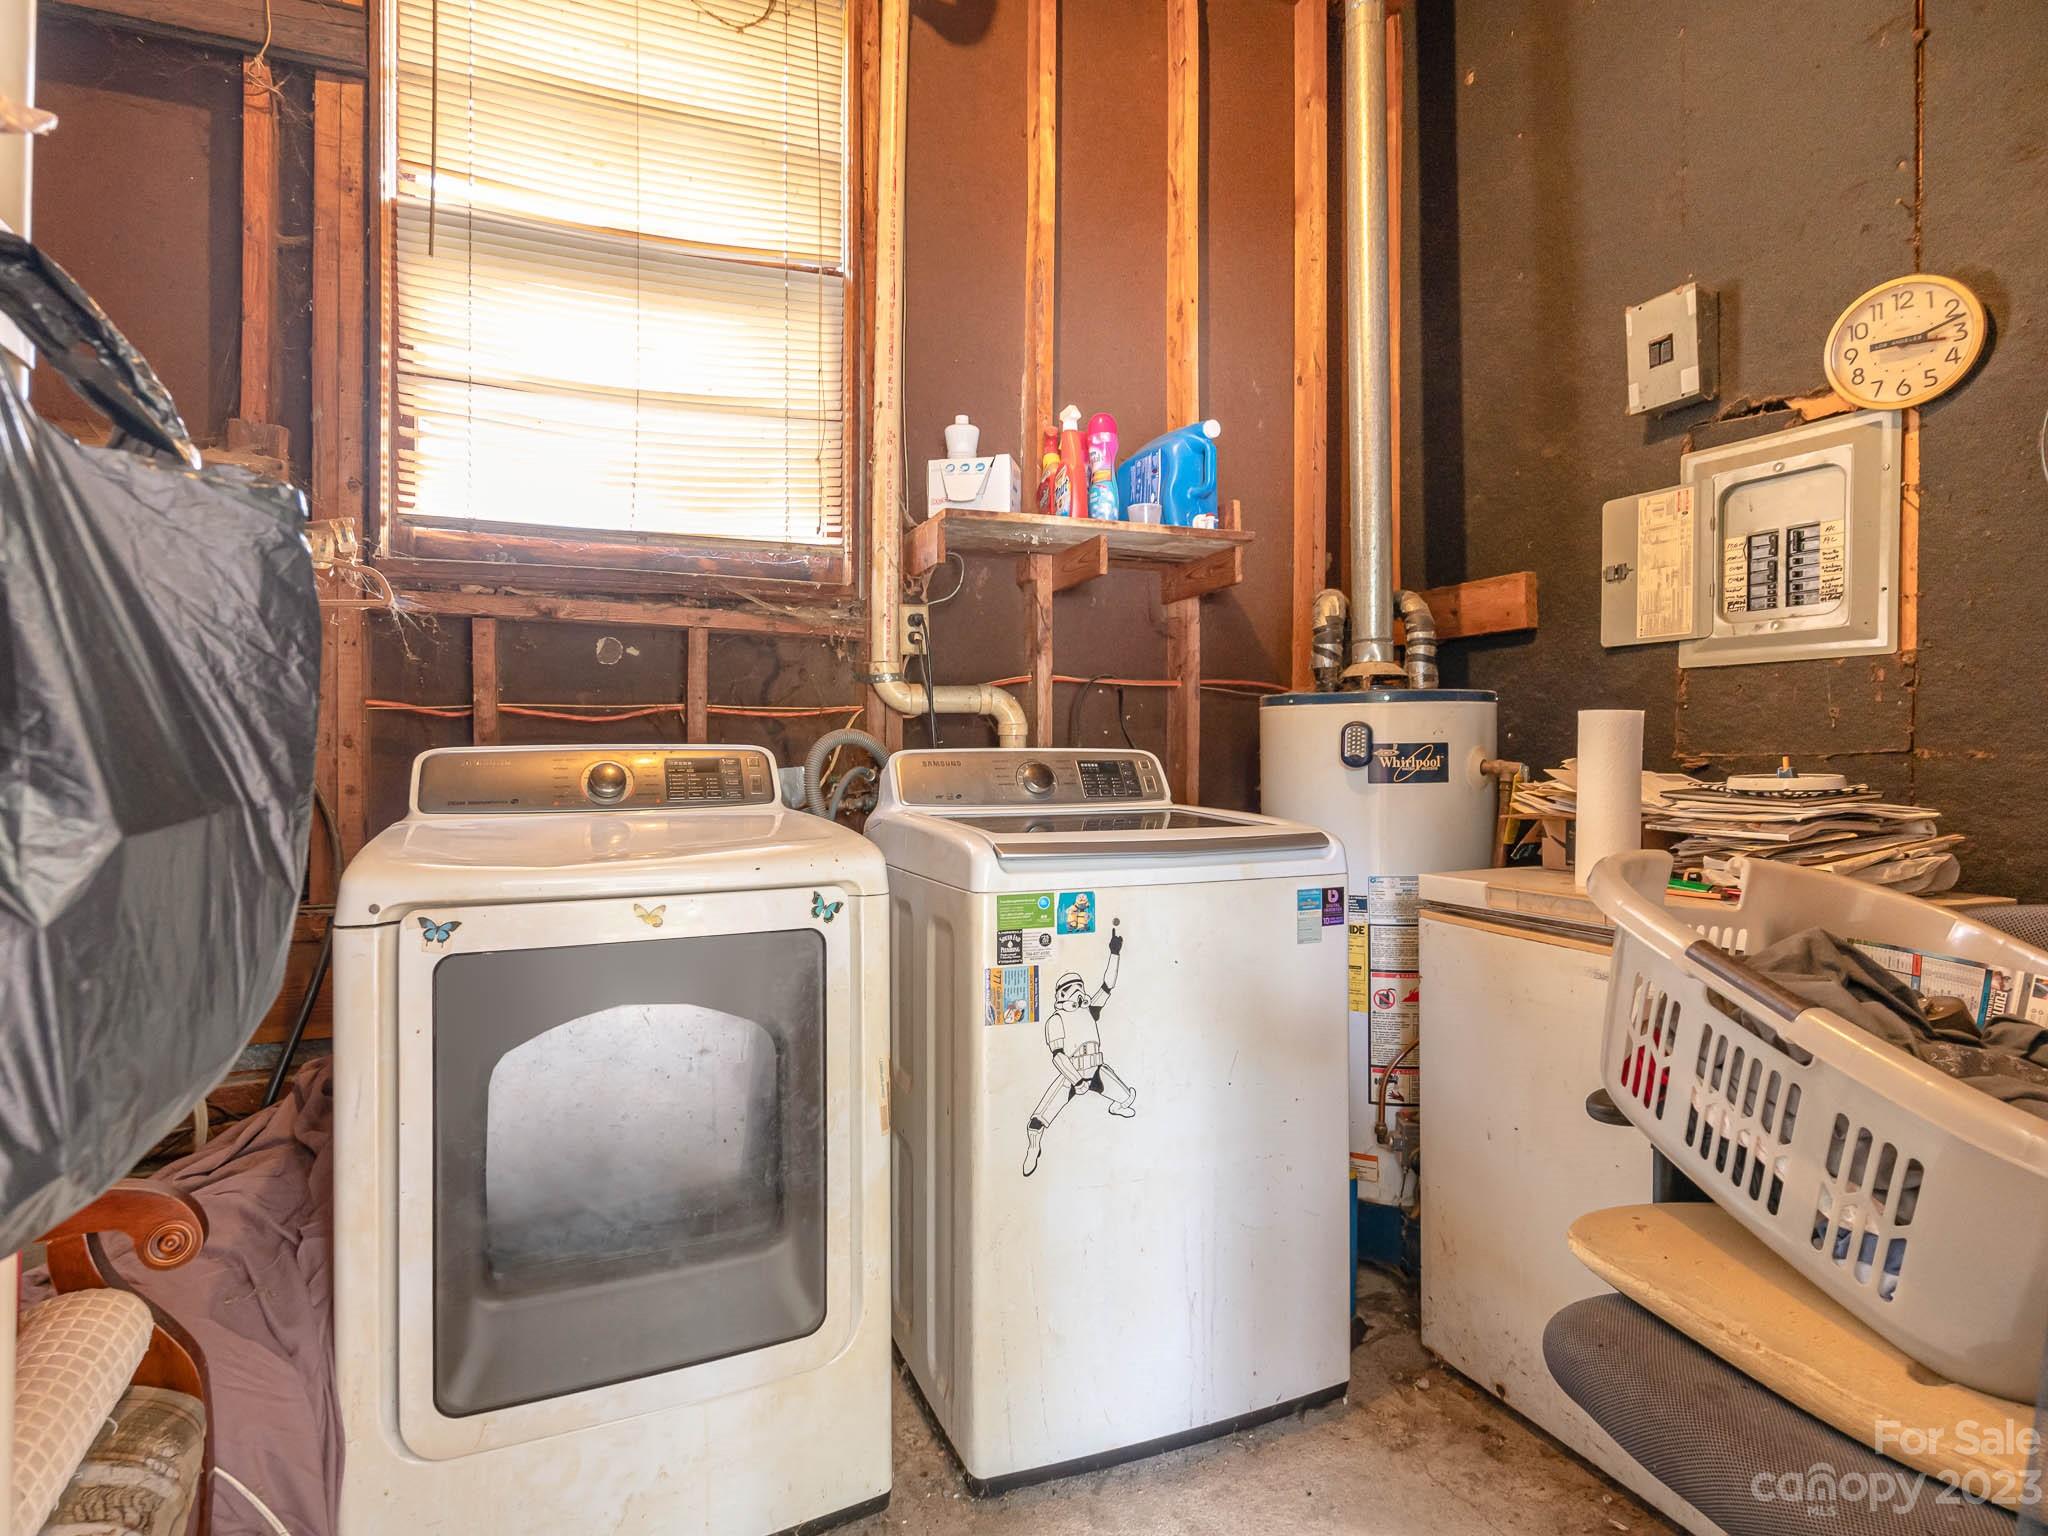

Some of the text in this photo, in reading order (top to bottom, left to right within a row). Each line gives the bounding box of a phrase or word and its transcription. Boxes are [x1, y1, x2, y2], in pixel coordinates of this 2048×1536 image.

[1891, 290, 1914, 312] 12
[1926, 290, 1934, 309] 1
[1944, 299, 1961, 318] 2
[1869, 302, 1884, 322] 11
[1847, 322, 1869, 342] 10
[1953, 321, 1969, 342] 3
[1843, 348, 1859, 366] 9
[1944, 346, 1962, 365] 4
[1851, 367, 1865, 386] 8
[1923, 368, 1938, 388] 5
[1870, 380, 1884, 398] 7
[1895, 378, 1912, 397] 6
[921, 760, 962, 768] SAMSUNG
[1380, 755, 1441, 771] Whirlpool
